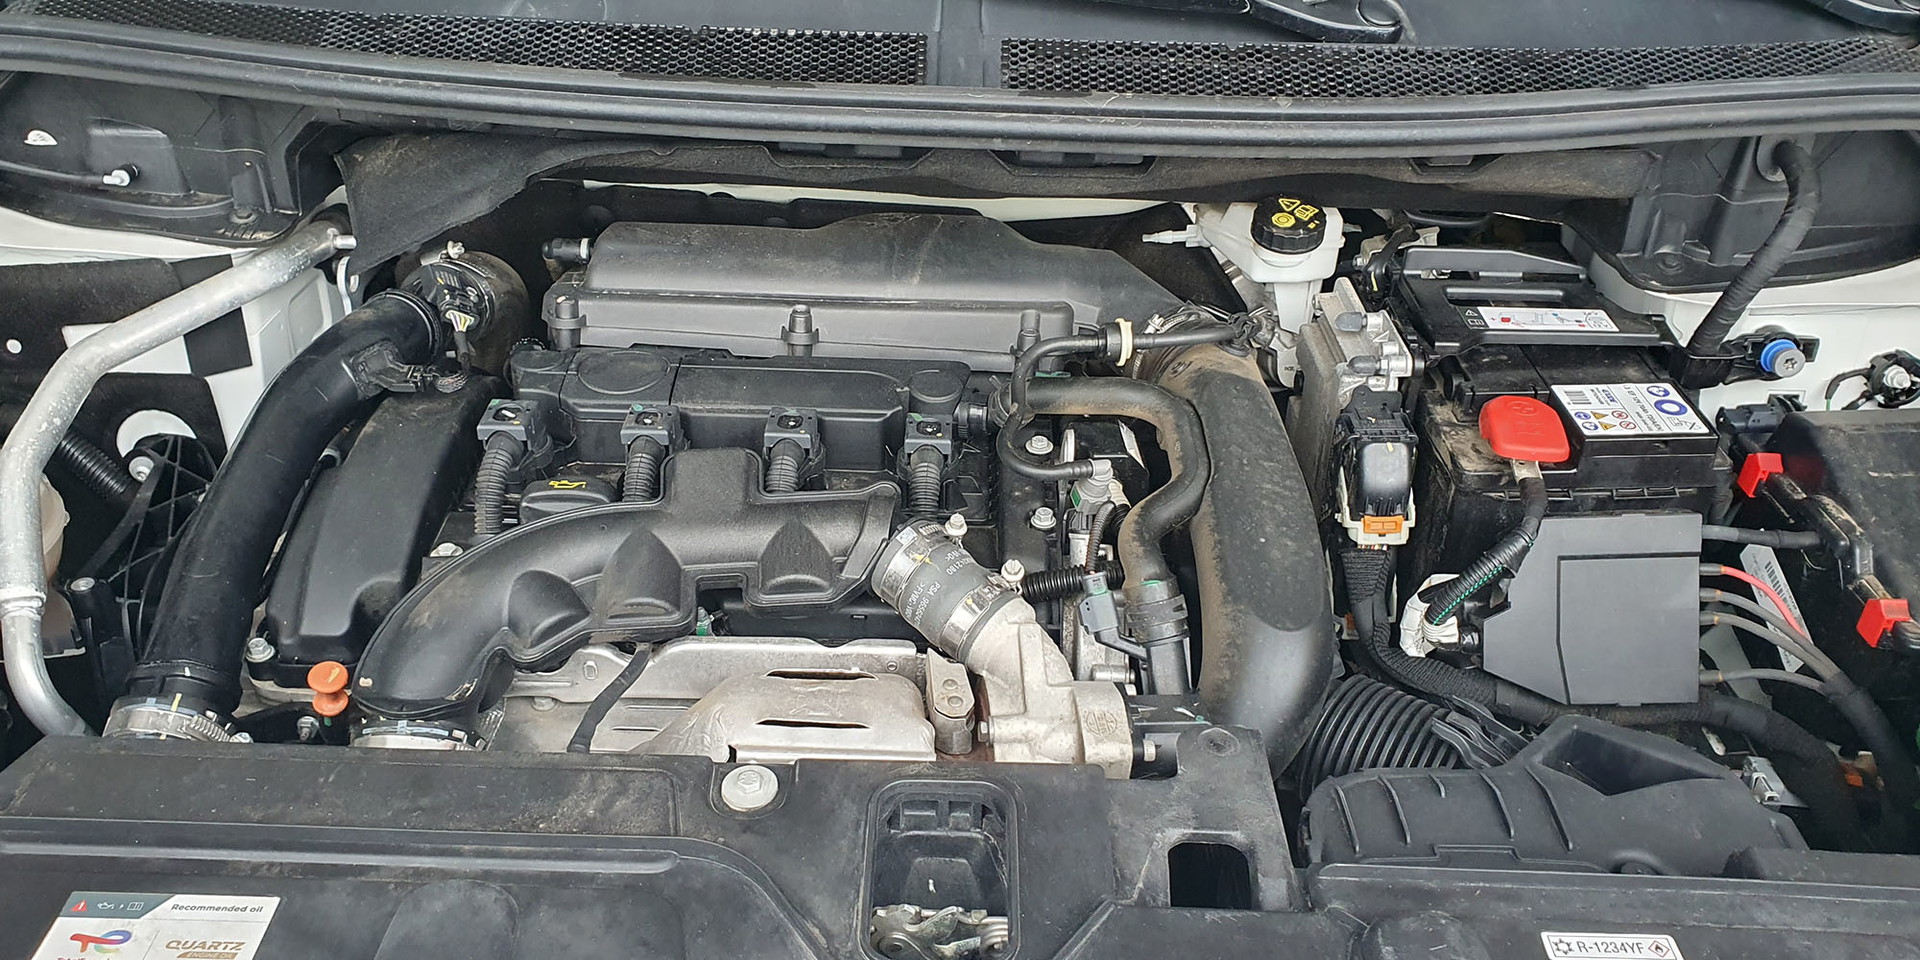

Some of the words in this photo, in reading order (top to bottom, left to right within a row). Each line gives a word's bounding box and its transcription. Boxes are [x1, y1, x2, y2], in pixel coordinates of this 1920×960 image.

[927, 581, 941, 596] PSA
[171, 904, 248, 913] Recommended
[165, 940, 246, 951] QUARTZ
[1576, 941, 1644, 955] R-1234YF
